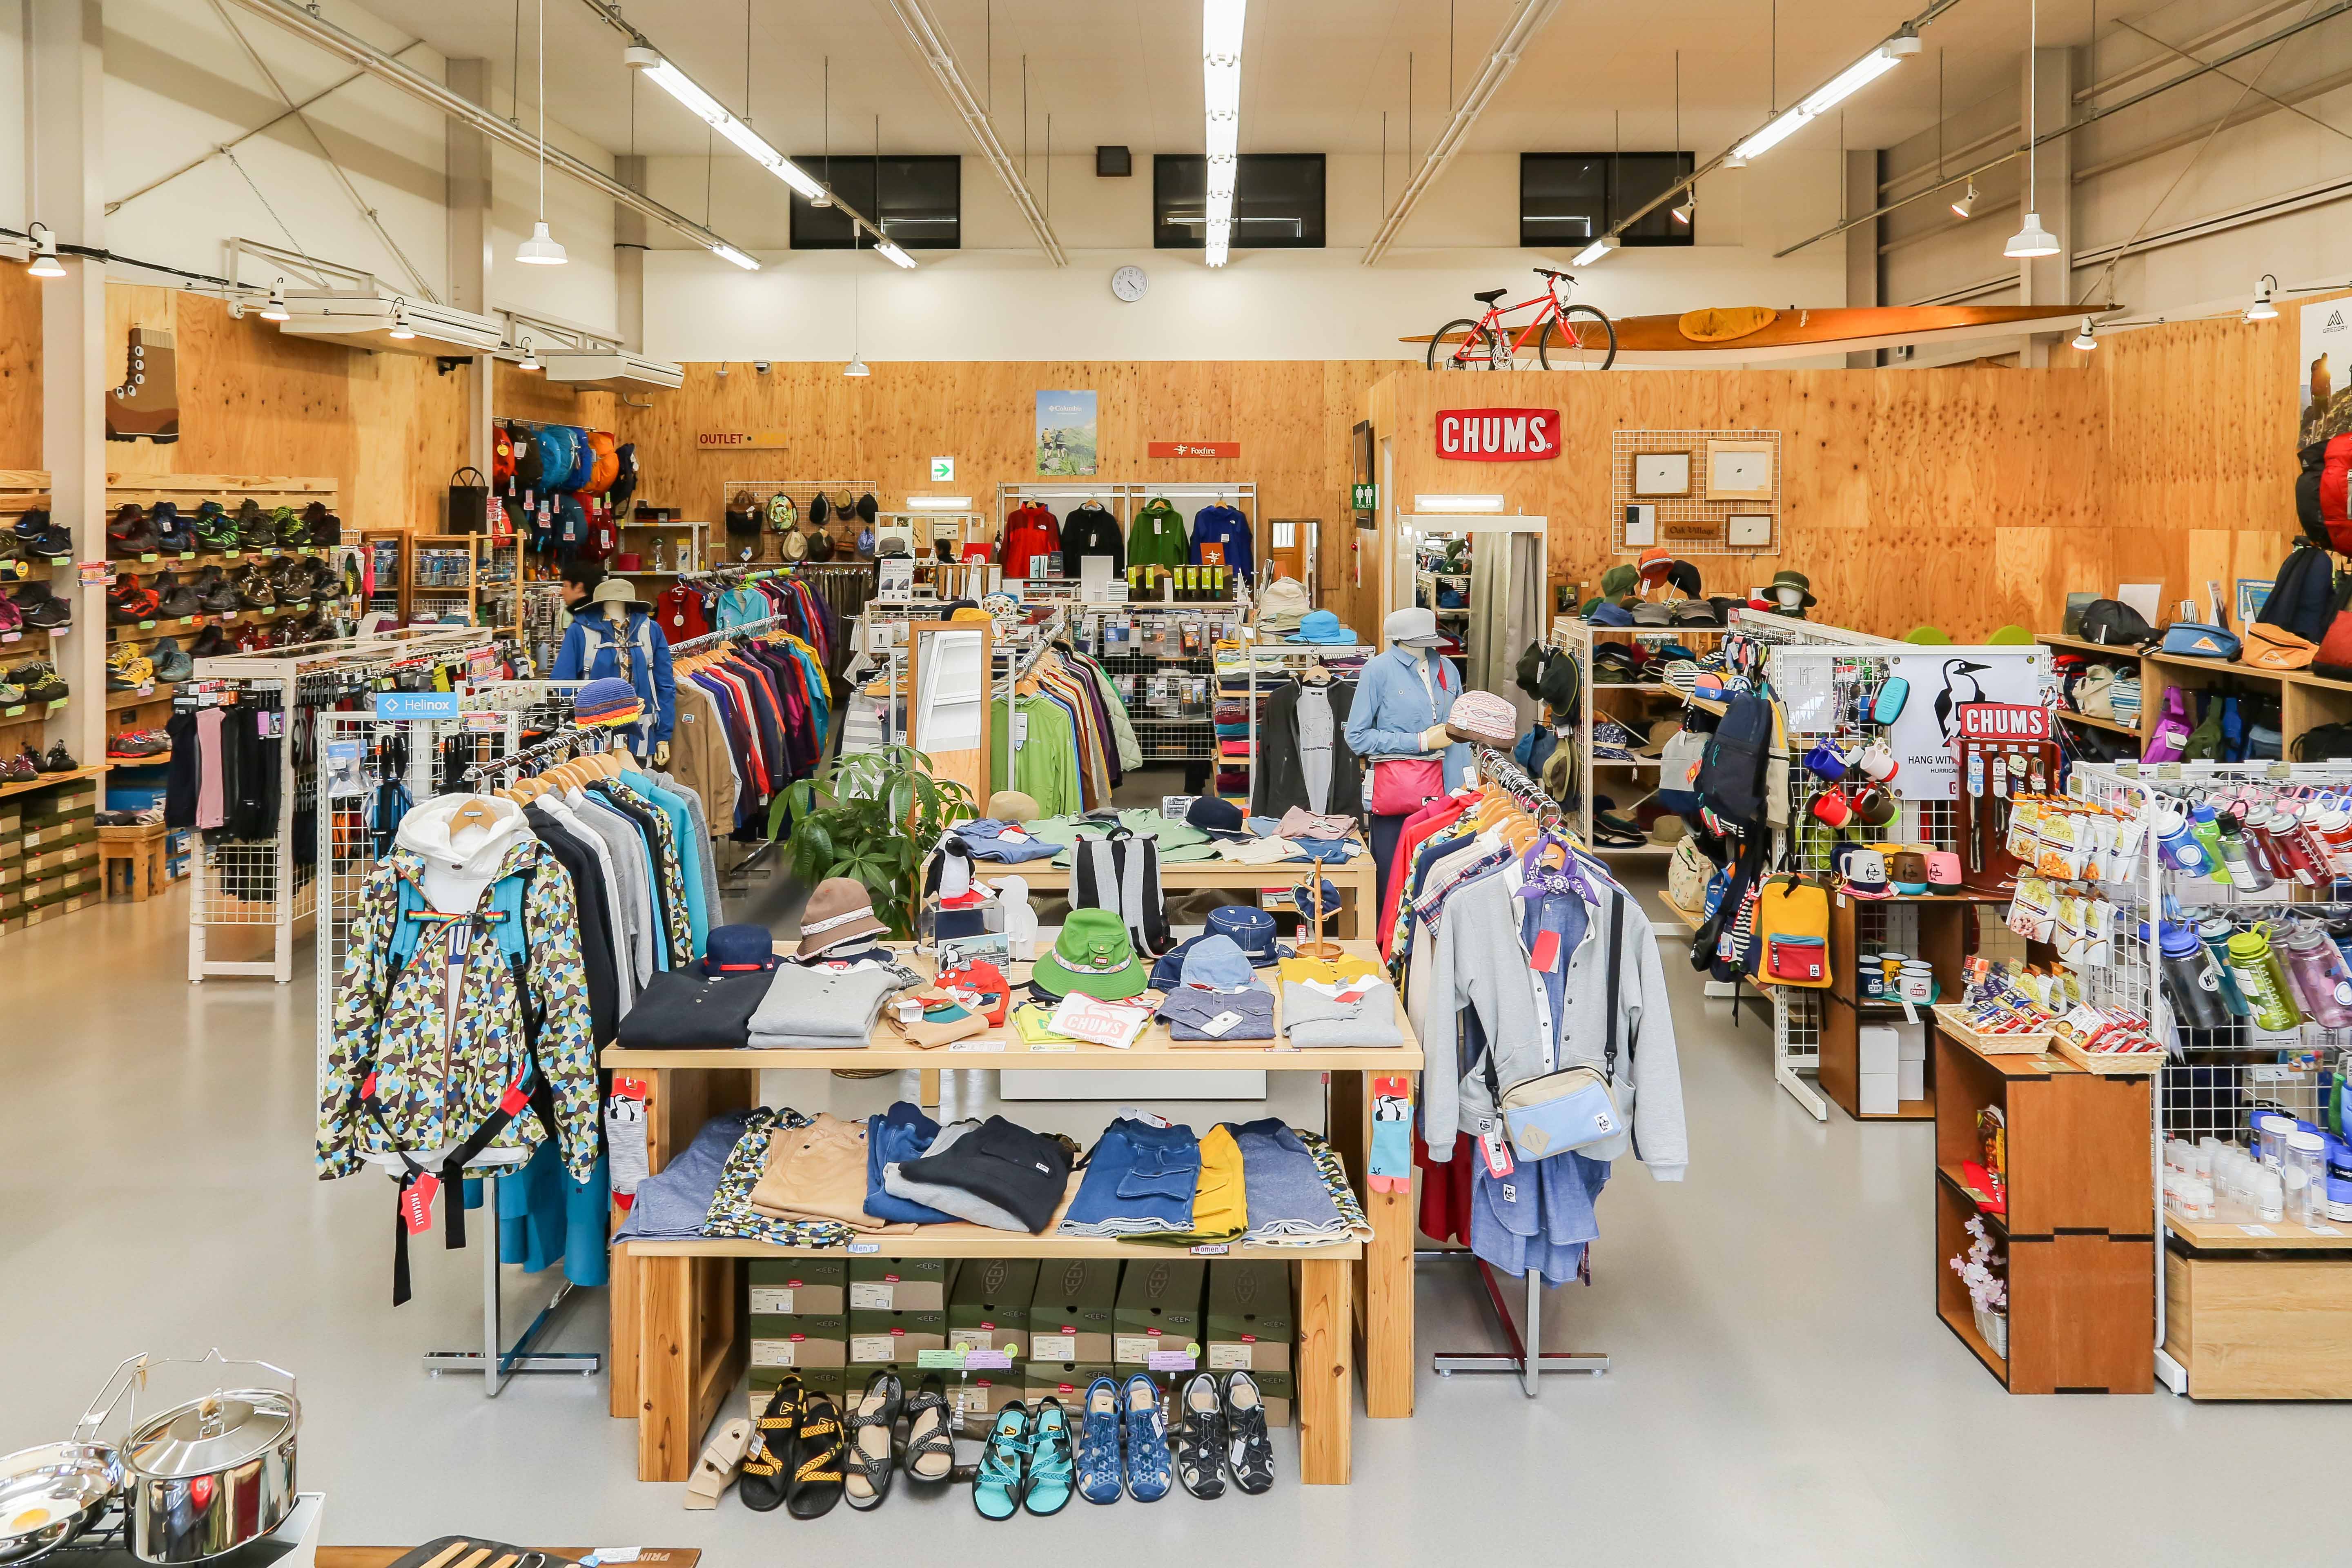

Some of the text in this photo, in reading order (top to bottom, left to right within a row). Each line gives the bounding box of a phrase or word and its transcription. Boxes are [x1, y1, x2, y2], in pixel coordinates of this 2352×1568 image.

[2323, 325, 2348, 334] GREGORY
[699, 433, 743, 444] OUTLET
[1442, 416, 1546, 453] CHUMS
[1670, 526, 1719, 535] Oak Village
[405, 699, 450, 711] Helinox
[1967, 709, 2042, 734] CHUMS
[1908, 756, 1933, 764] HANG
[2203, 973, 2216, 987] H2
[956, 989, 975, 999] HUMS
[1067, 1016, 1122, 1035] CHUMS
[1064, 1031, 1098, 1042] HURRICANE
[410, 1192, 424, 1226] PACKABLE
[985, 1262, 1004, 1294] KEEN
[1064, 1262, 1084, 1296] KEEN
[1149, 1262, 1167, 1298] KEEN
